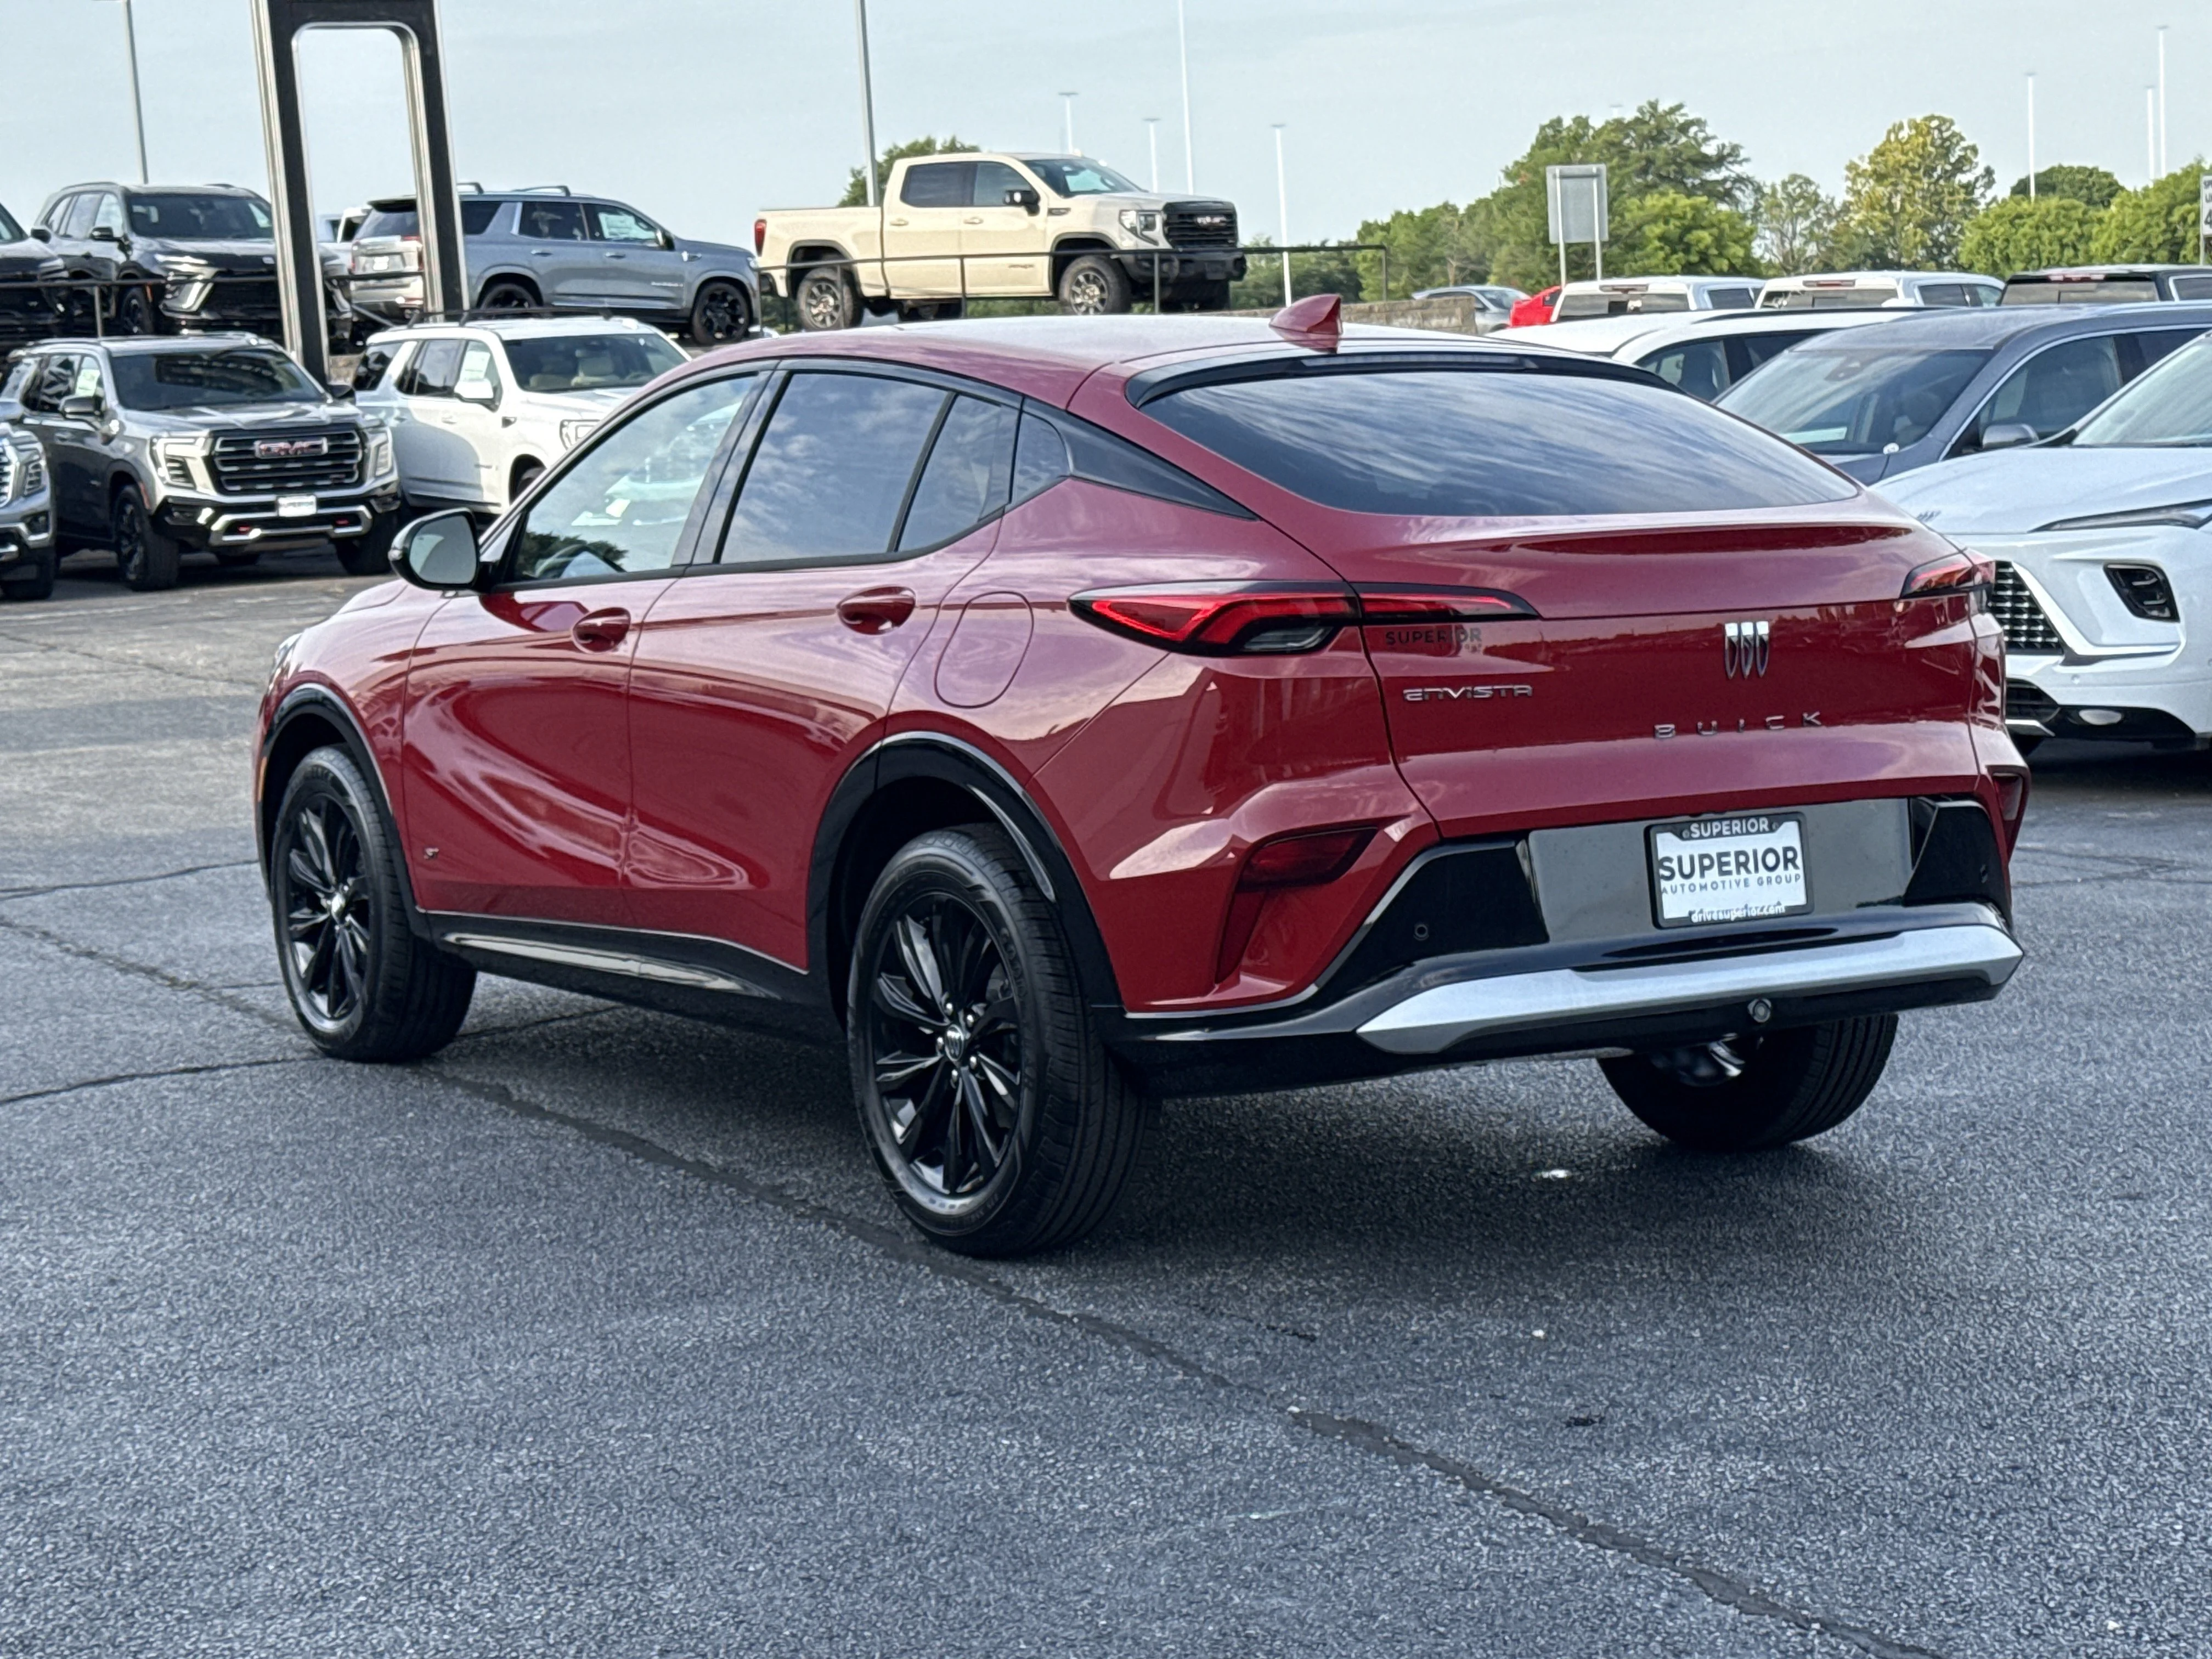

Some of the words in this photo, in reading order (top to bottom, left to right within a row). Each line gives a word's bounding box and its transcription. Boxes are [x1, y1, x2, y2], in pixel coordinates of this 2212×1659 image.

[259, 439, 323, 456] GMC
[1385, 628, 1483, 645] SUPERIOR
[1403, 685, 1533, 702] ENVISTA
[1654, 710, 1822, 738] BUICK
[1690, 817, 1770, 838] SUPERIOR
[1658, 845, 1801, 881] SUPERIOR
[1661, 878, 1751, 895] AUTOMOTIVE
[1757, 873, 1802, 887] GROUP
[1691, 903, 1786, 923] drivesuperior.com
